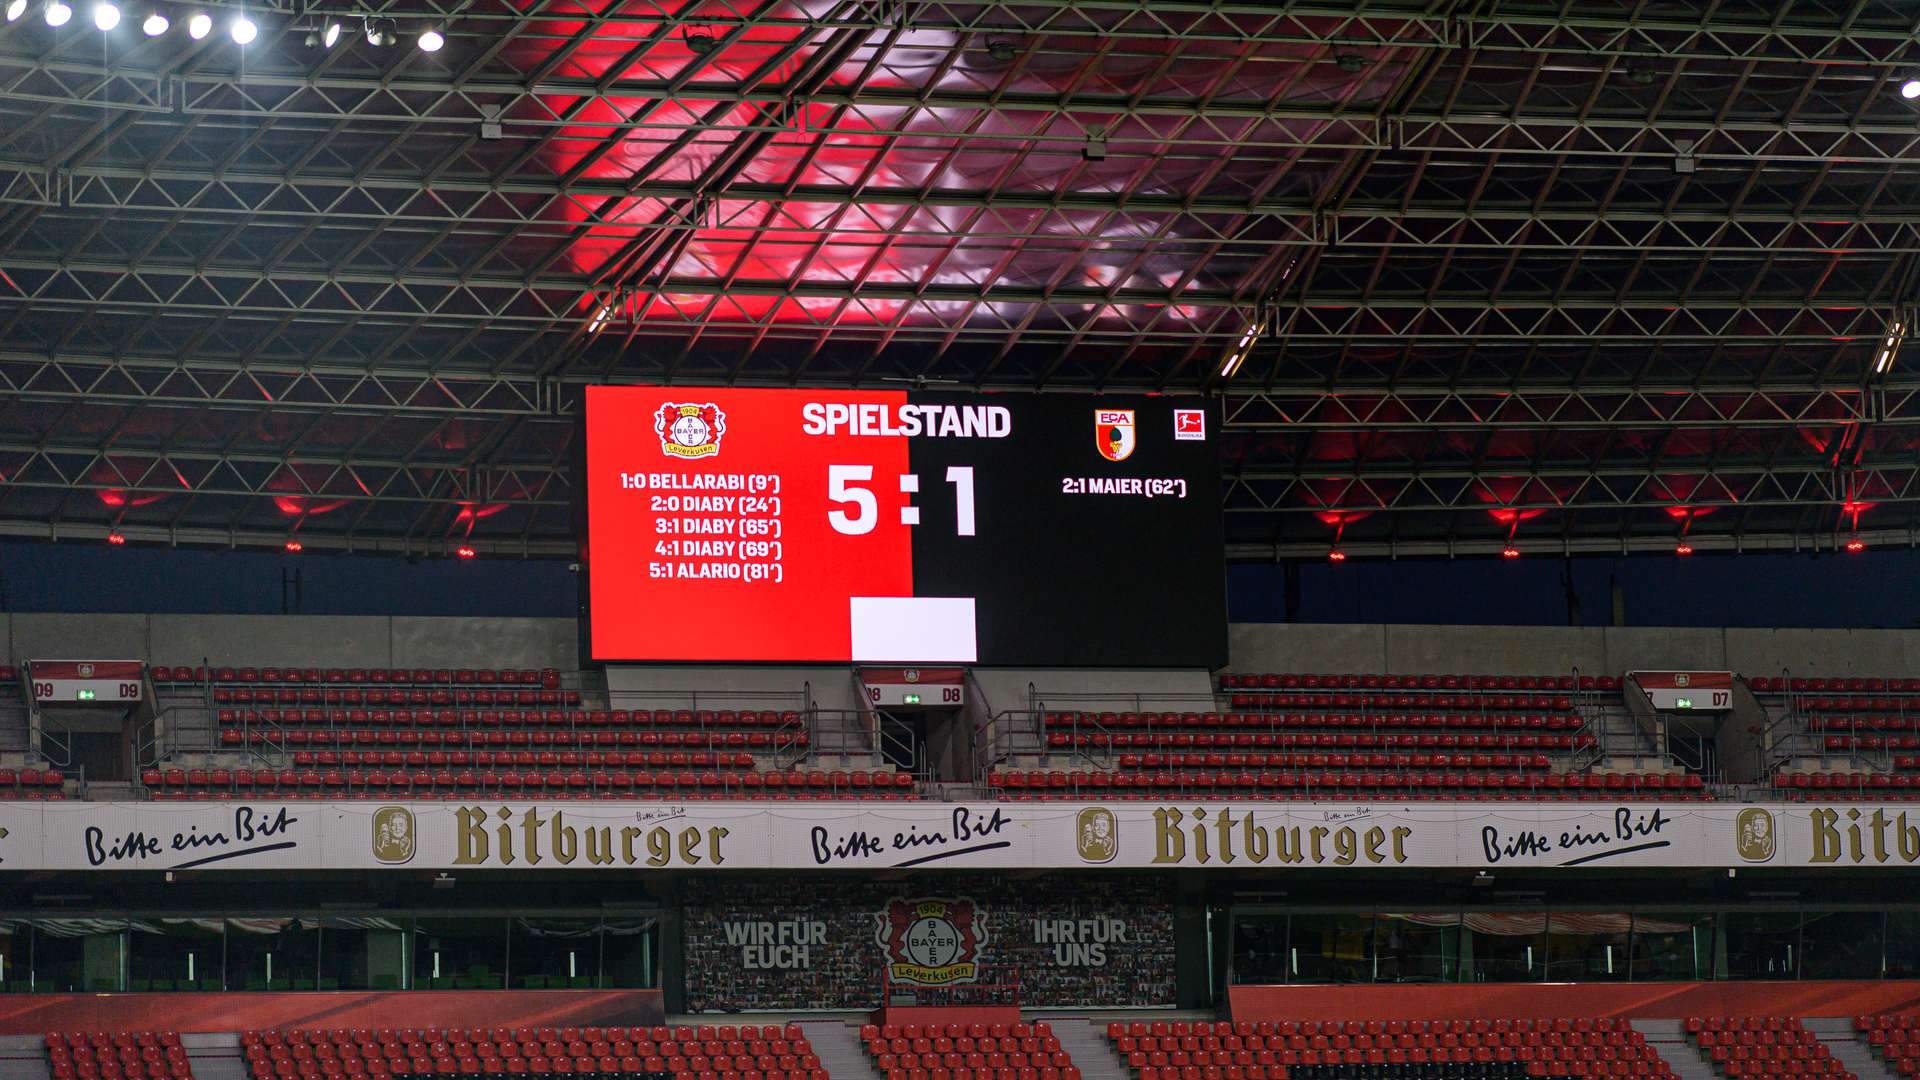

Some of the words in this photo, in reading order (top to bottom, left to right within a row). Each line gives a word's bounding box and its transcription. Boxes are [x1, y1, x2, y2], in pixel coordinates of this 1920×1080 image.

[802, 403, 1011, 438] SPIELSTAND
[668, 445, 713, 455] Leverkusen
[620, 473, 646, 489] 1:0
[650, 473, 745, 490] BELLARABI
[1062, 478, 1086, 494] 2:1
[1088, 478, 1143, 495] MAIER
[651, 496, 680, 512] 2:0
[683, 496, 736, 513] DIABY
[827, 465, 878, 536] 5
[945, 466, 976, 536] 1
[655, 518, 680, 534] 3:1
[683, 518, 736, 534] DIABY
[655, 540, 680, 556] 4:1
[683, 540, 736, 556] DIABY
[649, 562, 674, 578] 5:1
[676, 562, 741, 579] ALARIO
[34, 682, 54, 698] D9
[119, 683, 138, 698] D9
[943, 688, 961, 702] D8
[1713, 692, 1728, 706] D7
[85, 826, 163, 866] Bitte
[171, 825, 229, 851] ein
[235, 806, 297, 841] Bit
[452, 805, 730, 867] Bitburger
[811, 825, 884, 865] Bitte
[892, 825, 947, 849] ein
[952, 806, 1012, 841] Bit
[1151, 806, 1412, 866] Bitburger
[1482, 825, 1551, 863] Bitte
[1558, 824, 1610, 849] ein
[1614, 806, 1671, 841] Bit
[920, 905, 943, 914] 1904
[724, 921, 775, 945] WIR
[778, 915, 829, 945] FÜR
[1034, 919, 1076, 943] IHR
[1078, 915, 1127, 943] FÜR
[911, 938, 955, 947] BAYER
[743, 945, 809, 969] EUCH
[1055, 942, 1106, 967] UNS
[898, 966, 969, 981] Leverkusen
